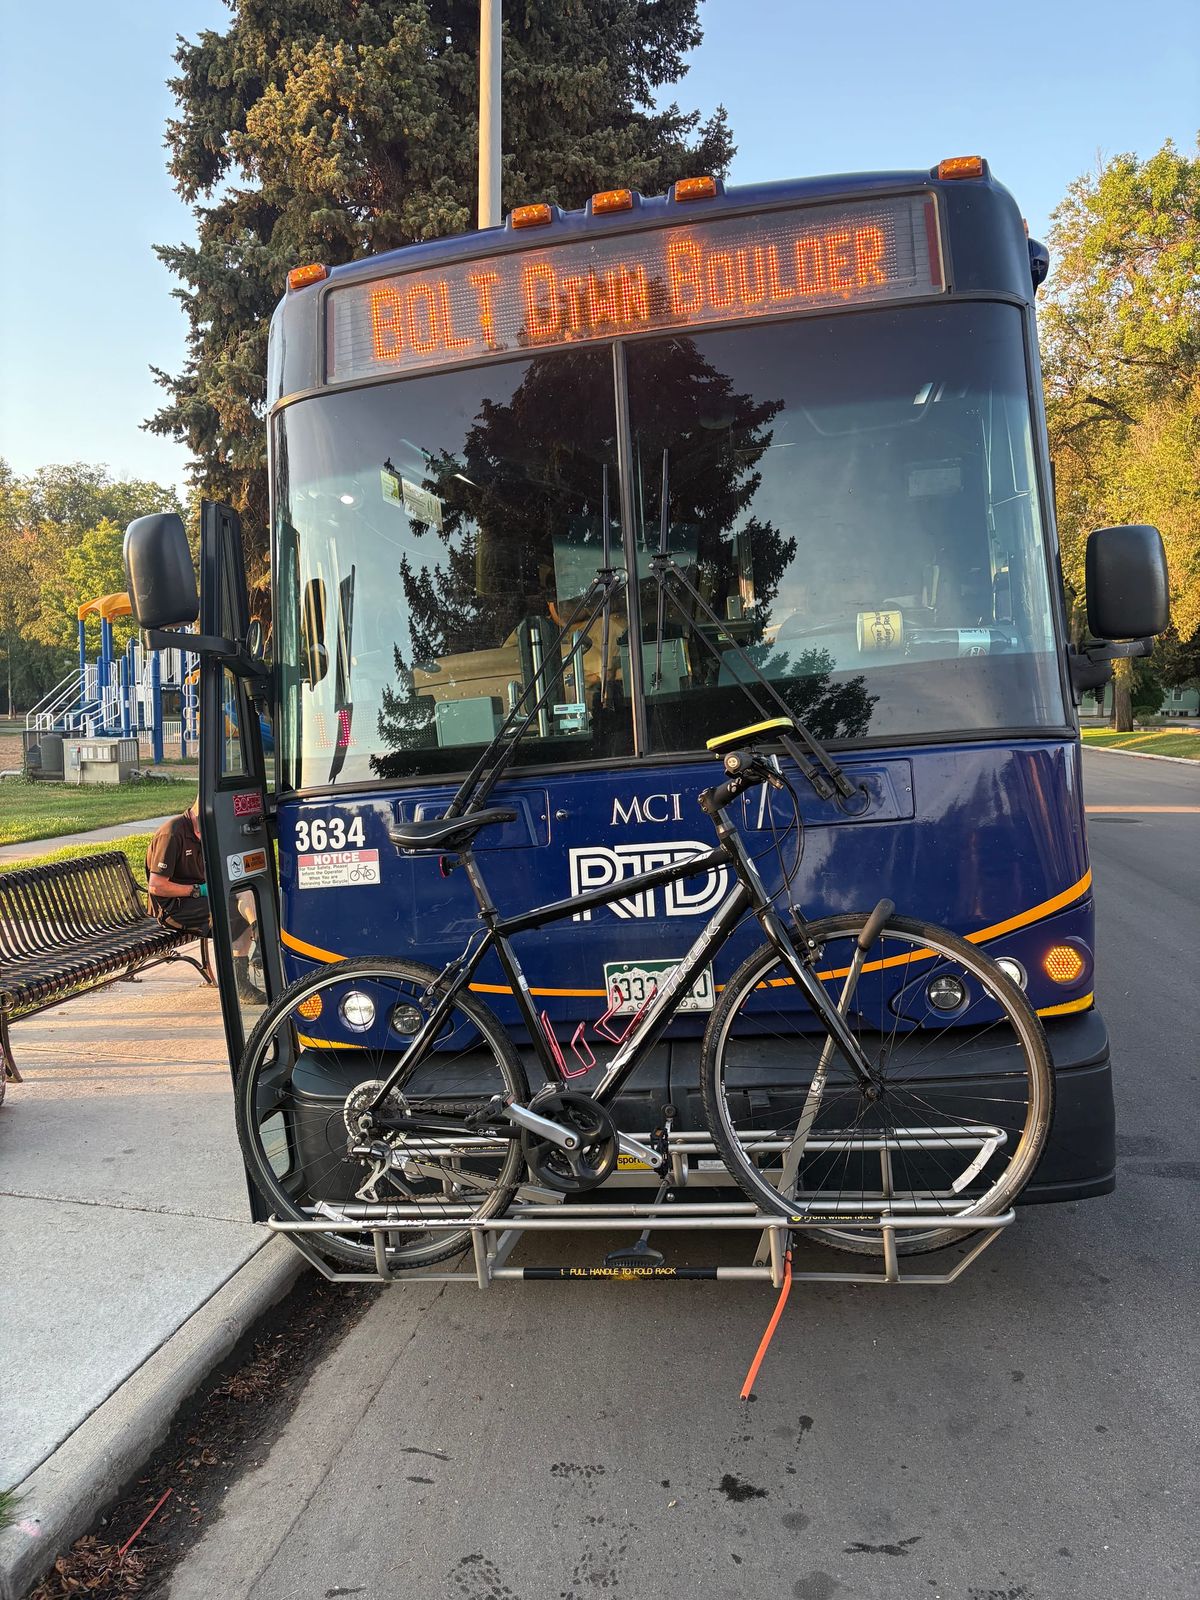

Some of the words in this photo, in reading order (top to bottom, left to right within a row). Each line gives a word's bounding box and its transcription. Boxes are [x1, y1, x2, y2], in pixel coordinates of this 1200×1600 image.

[370, 271, 499, 361] BOLT
[609, 793, 684, 826] MCI
[295, 816, 366, 852] 3634
[313, 852, 360, 865] NOTICE
[568, 840, 729, 922] RTD
[662, 919, 721, 997] TREK
[713, 986, 740, 1042] BONTRAGER
[569, 1268, 588, 1276] PULL
[589, 1268, 619, 1276] HANDLE
[621, 1267, 632, 1275] TO
[633, 1267, 653, 1275] FOLD
[655, 1267, 677, 1275] RACK
